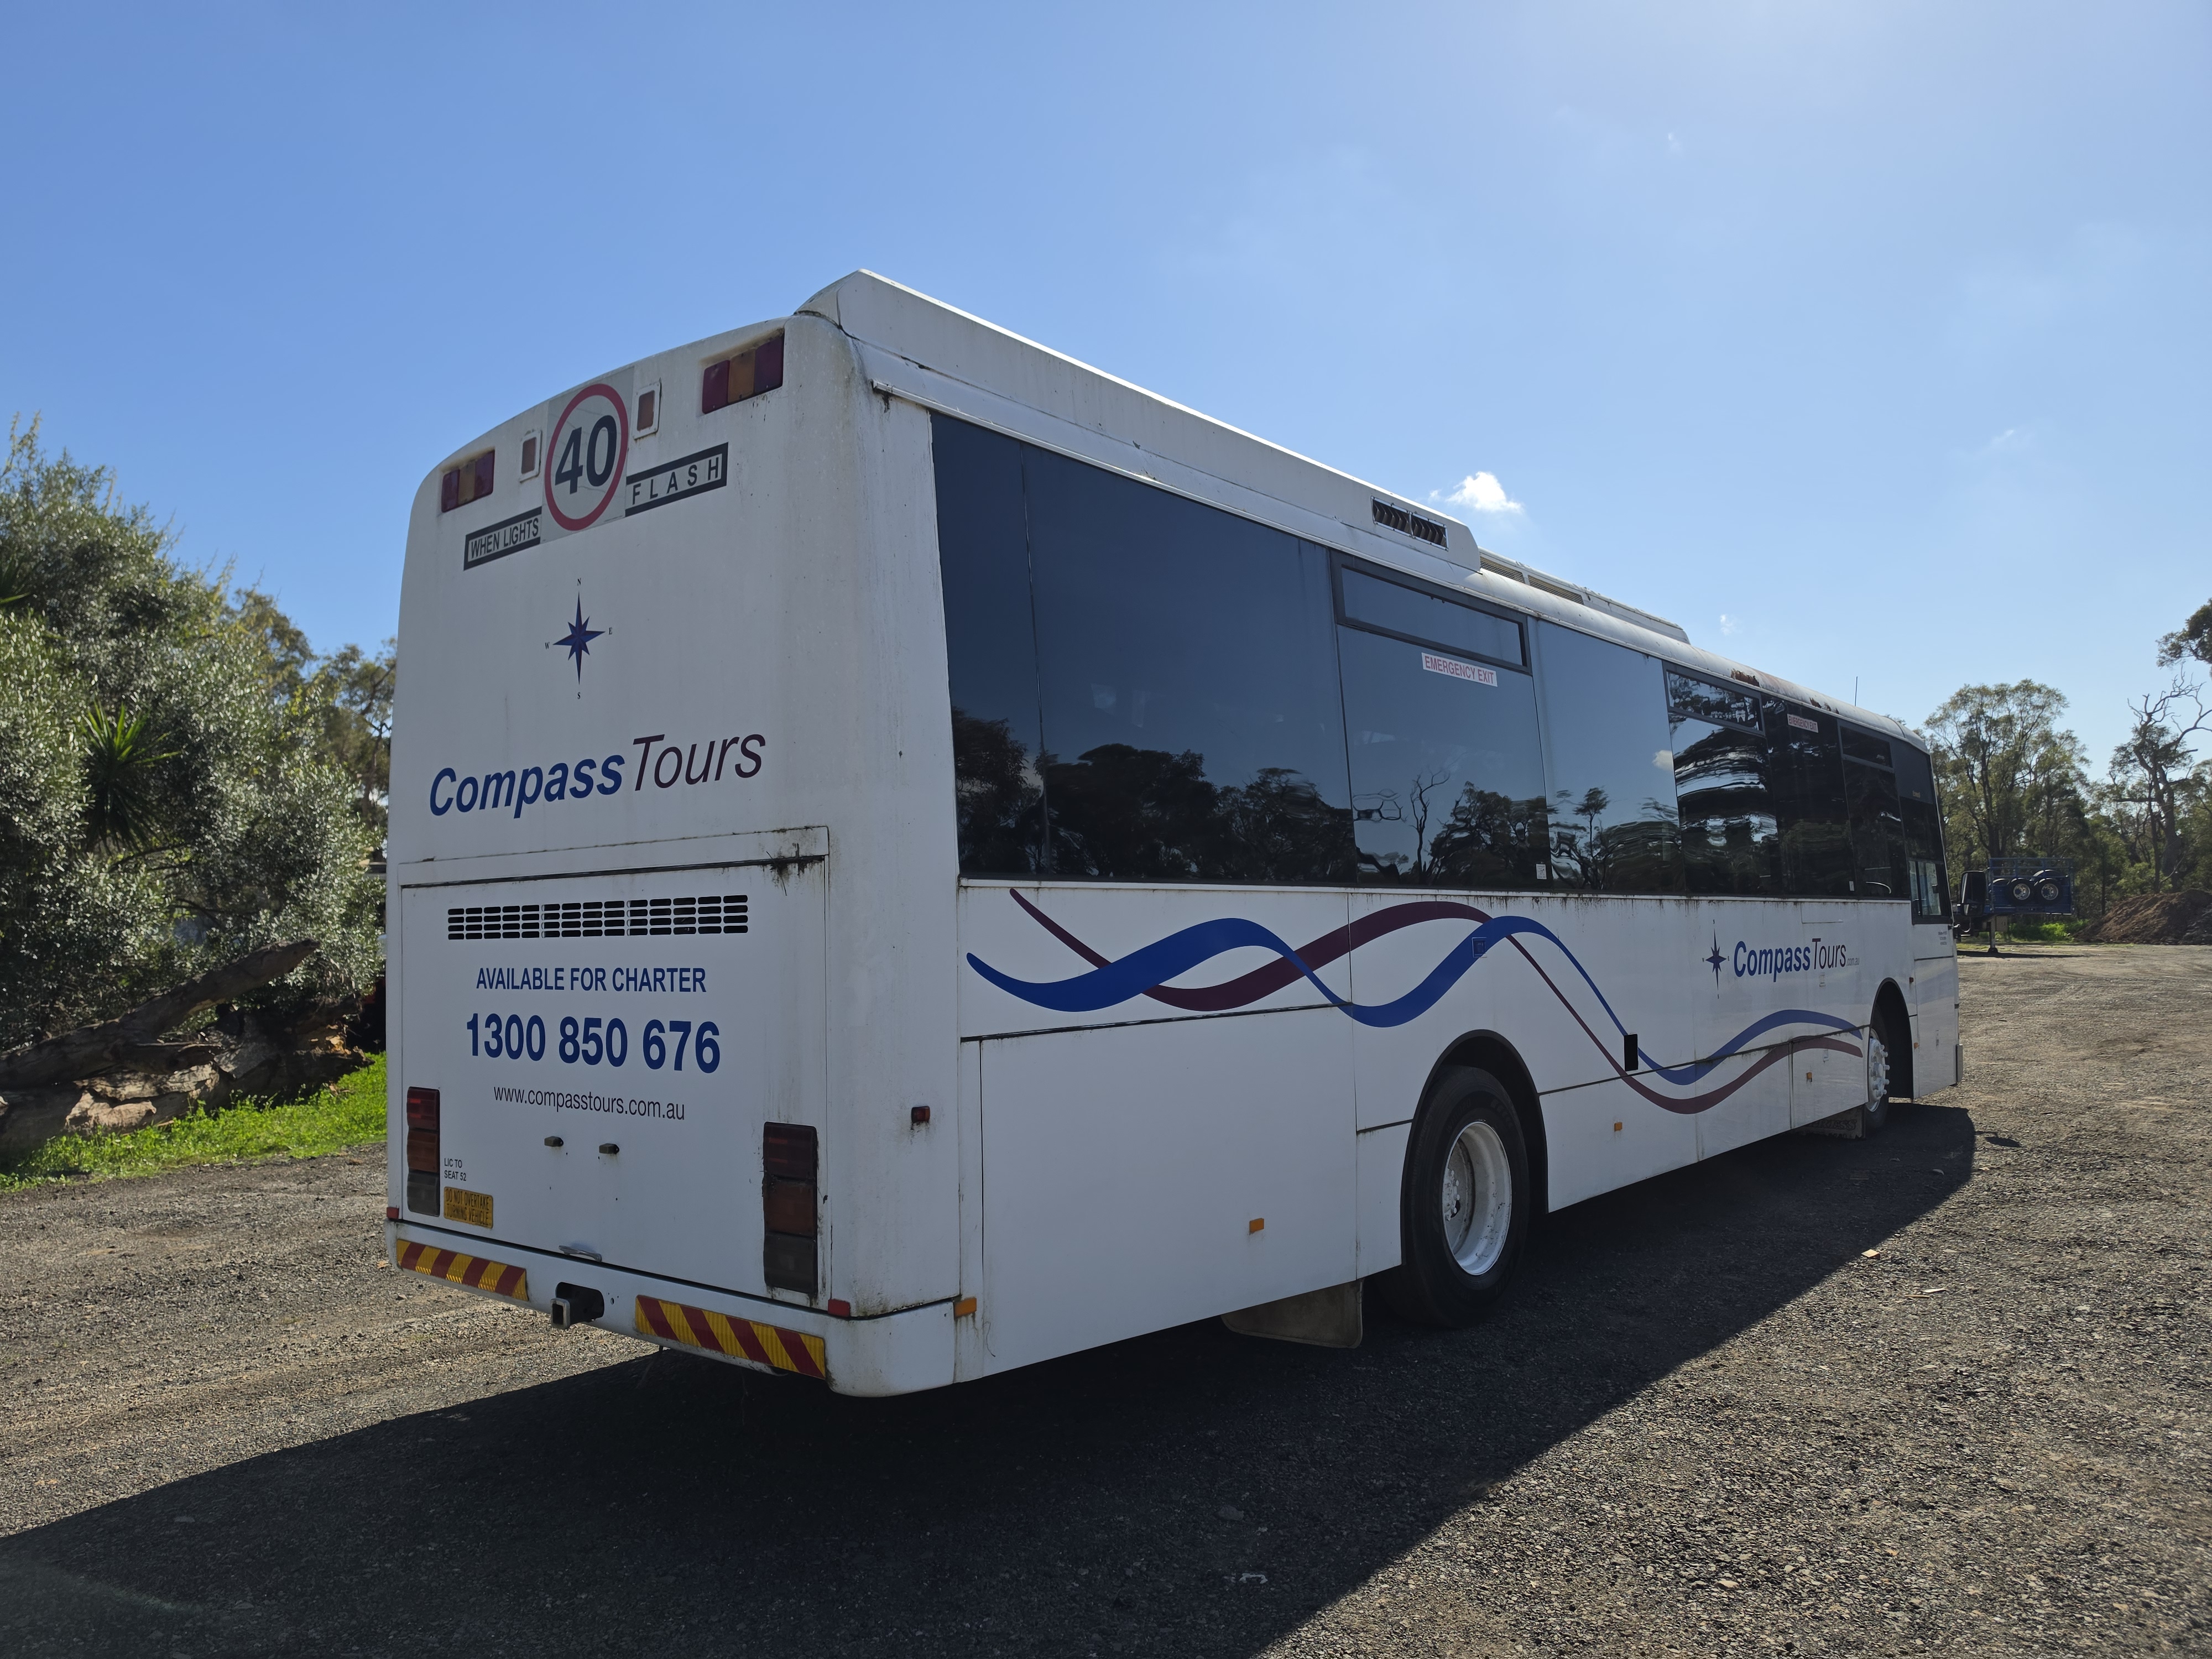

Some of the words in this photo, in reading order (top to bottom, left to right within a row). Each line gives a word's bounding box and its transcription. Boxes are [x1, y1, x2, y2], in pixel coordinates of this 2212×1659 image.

[555, 415, 617, 494] 40
[632, 457, 719, 505] FLASH
[471, 531, 499, 559] WHEN
[503, 517, 539, 547] LIGHTS
[577, 578, 581, 586] N
[1425, 655, 1475, 680] EMERGENCY
[1478, 669, 1494, 684] EXIT
[476, 967, 565, 990] AVAILABLE
[570, 967, 607, 992] FOR
[612, 967, 707, 993] CHARTER
[466, 1013, 546, 1062] 1300
[559, 1016, 628, 1067] 850
[643, 1019, 721, 1074] 676
[493, 1086, 685, 1120] www.compasstours.com.au
[444, 1157, 453, 1167] LIC
[455, 1159, 462, 1168] TO
[444, 1170, 459, 1180] SEAT
[460, 1172, 467, 1182] 52
[446, 1188, 452, 1202] DO
[453, 1190, 463, 1204] NOT
[465, 1192, 489, 1211] OVERTAKE
[447, 1203, 467, 1220] TURNING
[469, 1207, 489, 1225] VEHICLE
